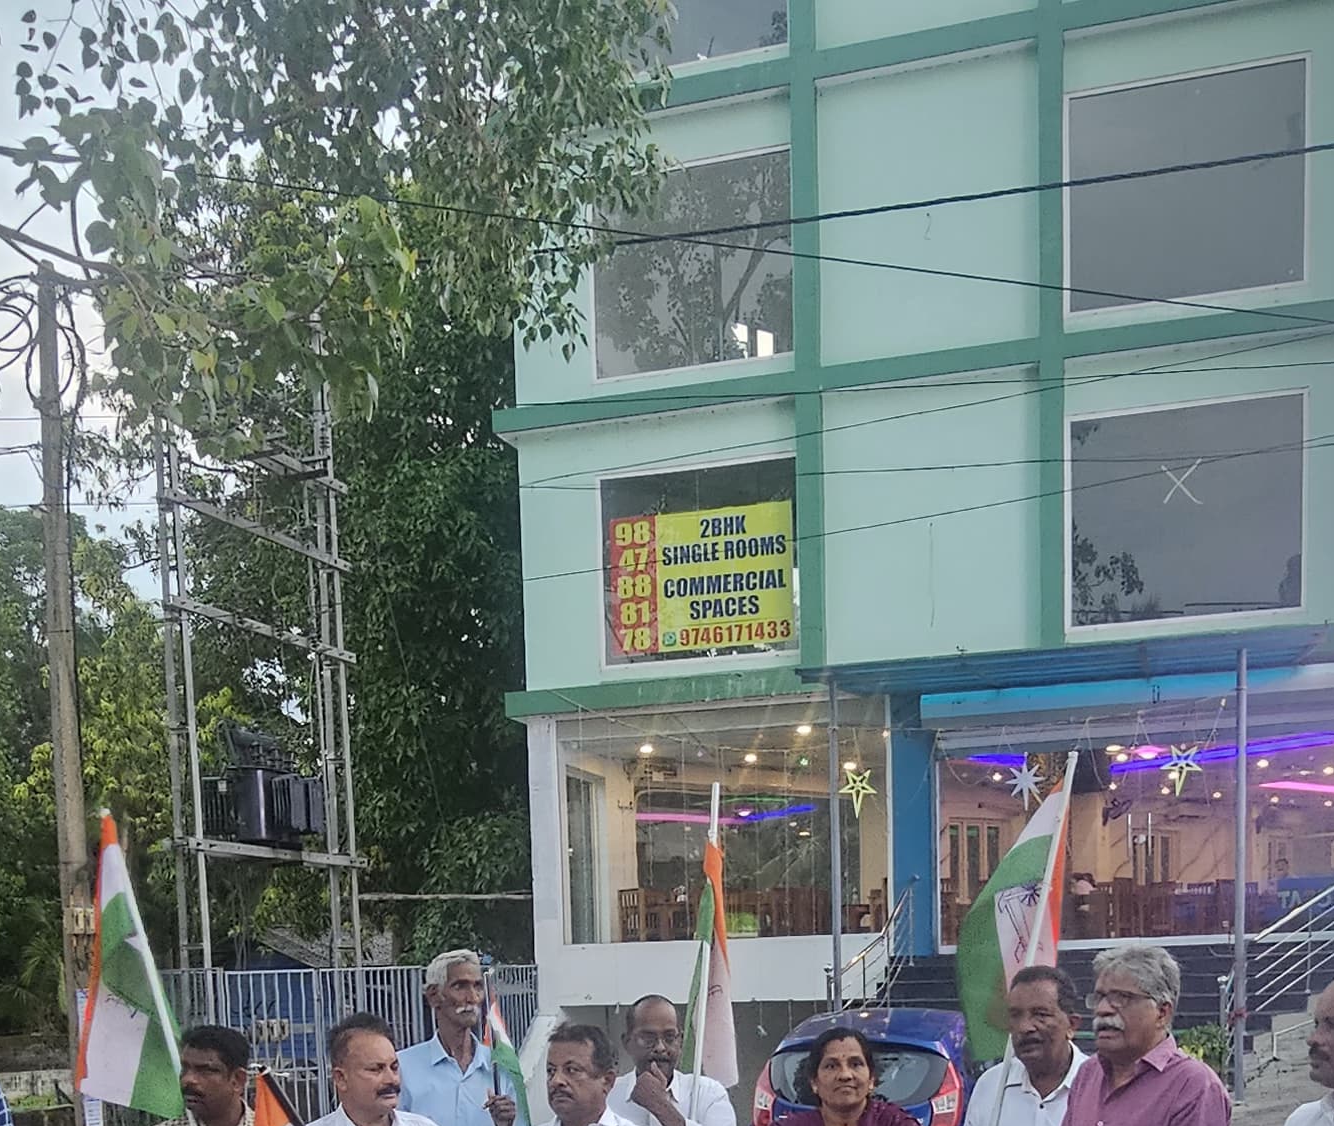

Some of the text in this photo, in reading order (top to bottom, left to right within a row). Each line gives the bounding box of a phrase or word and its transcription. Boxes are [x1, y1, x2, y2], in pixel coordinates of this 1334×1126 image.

[615, 521, 651, 546] 98
[700, 515, 746, 538] 2BHK
[619, 548, 649, 571] 47
[662, 534, 786, 566] SINGLE ROOMS
[618, 575, 651, 599] 88
[664, 569, 787, 598] COMMERCIAL
[620, 602, 650, 625] 81
[690, 595, 759, 620] SPACES
[620, 627, 651, 650] 78
[679, 619, 791, 646] 9746171433
